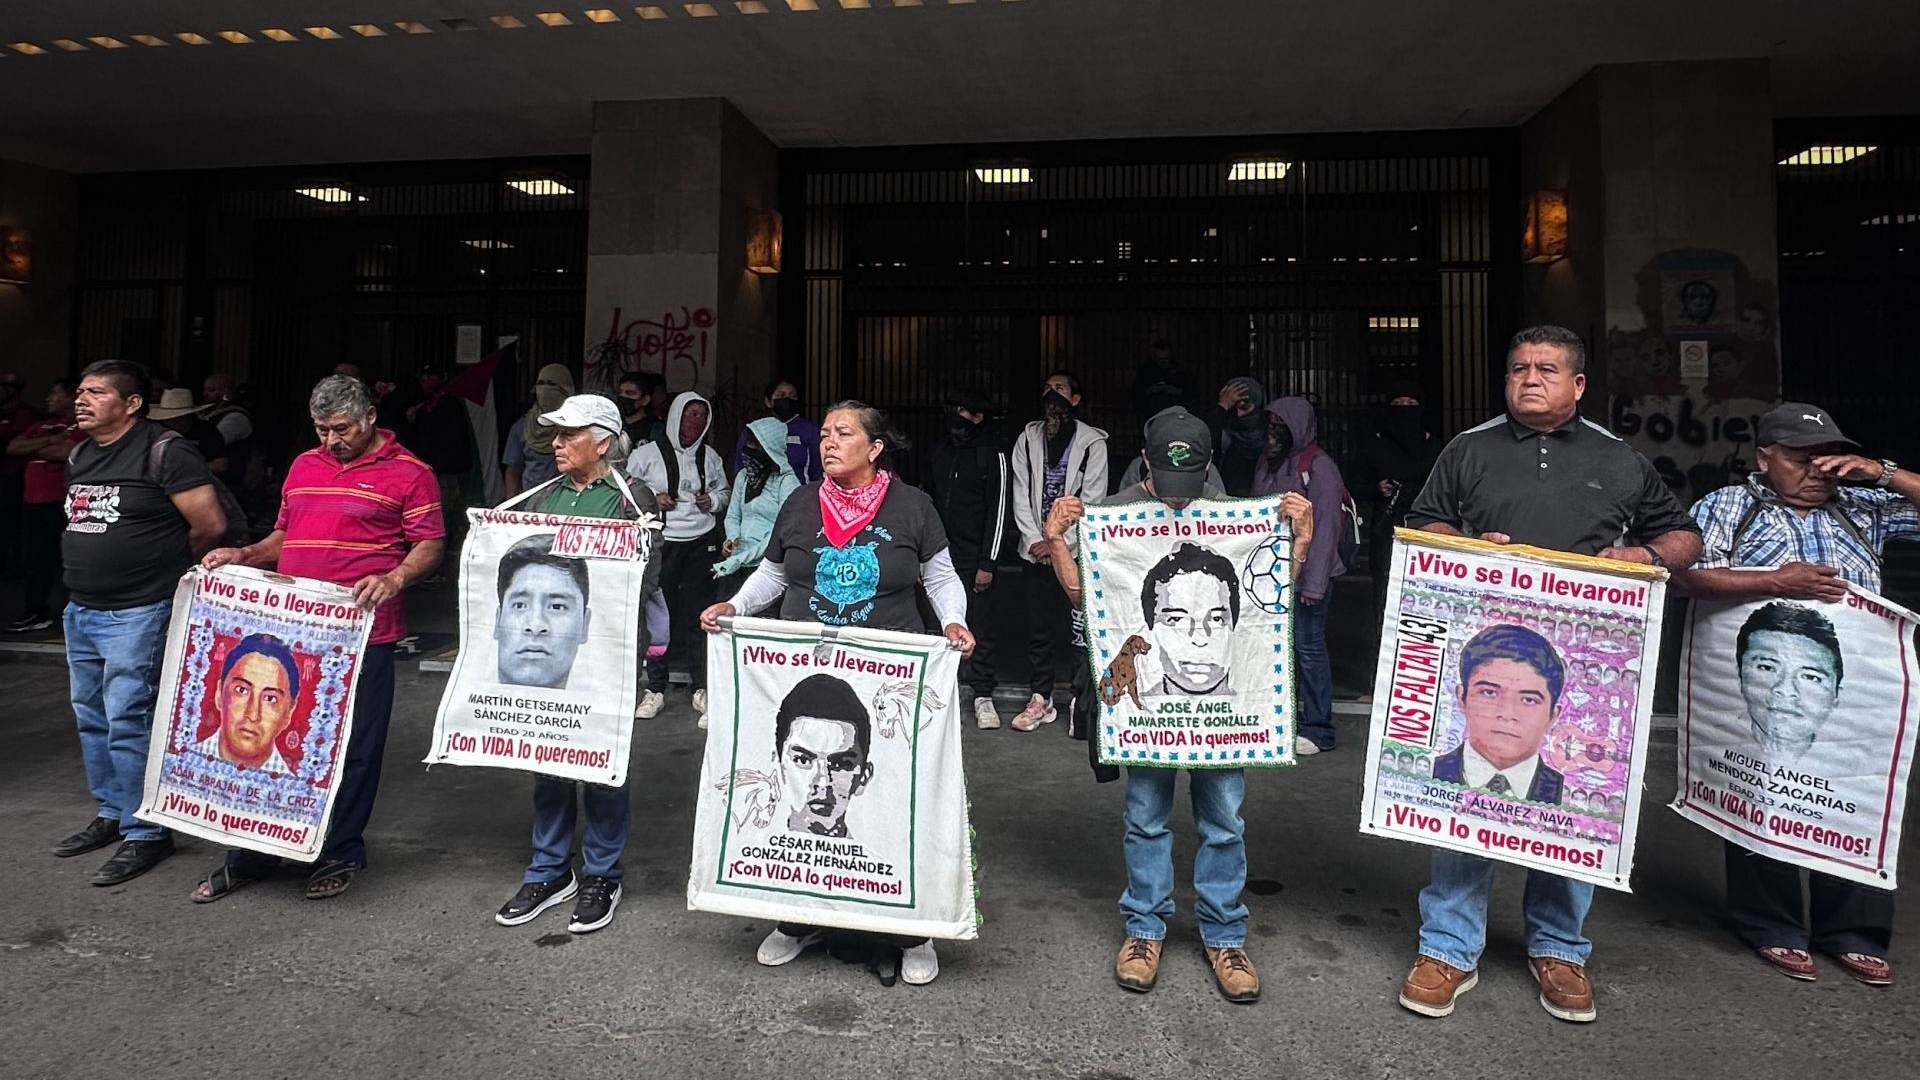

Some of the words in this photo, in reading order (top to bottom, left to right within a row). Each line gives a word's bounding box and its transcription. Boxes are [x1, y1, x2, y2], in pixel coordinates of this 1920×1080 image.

[554, 524, 585, 553] NOS
[1101, 524, 1146, 542] ¡Vivo
[1151, 525, 1170, 537] se
[1174, 521, 1191, 536] lo
[1196, 519, 1272, 537] llevaron!
[196, 574, 235, 597] ¡Vivo
[240, 588, 259, 602] se
[264, 588, 279, 607] lo
[837, 565, 856, 583] 43
[1409, 551, 1468, 579] ¡Vivo
[1475, 566, 1503, 585] se
[1511, 567, 1533, 590] lo
[1540, 572, 1645, 608] llevaron!
[851, 602, 874, 622] Sigue
[743, 645, 786, 666] ¡Vivo
[791, 653, 809, 667] se
[834, 649, 915, 679] llevaron!
[1393, 639, 1440, 705] FALTAN
[468, 693, 512, 708] MARTÍN
[515, 698, 591, 715] GETSEMANY
[474, 708, 531, 724] SÁNCHEZ
[534, 715, 581, 730] GARCÍA
[489, 727, 519, 736] EDAD
[522, 729, 535, 738] 20
[539, 730, 569, 742] AÑOS
[1128, 716, 1200, 728] NAVARRETE
[1204, 714, 1259, 728] GONZÁLEZ
[1388, 705, 1431, 745] NOS
[446, 732, 476, 752] ¡Con
[481, 735, 513, 757] VIDA
[518, 740, 530, 759] lo
[535, 745, 611, 769] queremos!
[1119, 730, 1148, 747] ¡Con
[1150, 730, 1187, 746] VIDA
[1190, 730, 1203, 746] lo
[1205, 729, 1270, 749] queremos!
[1709, 759, 1763, 789] MENDOZA
[1768, 782, 1856, 814] ZACARIAS
[1724, 750, 1770, 774] MIGUEL
[1774, 766, 1835, 792] ÁNGEL
[247, 786, 260, 799] DE
[268, 791, 281, 804] LA
[288, 795, 317, 809] CRUZ
[1422, 785, 1463, 803] JORGE
[1540, 811, 1574, 827] NAVA
[1729, 783, 1754, 799] EDAD
[1758, 795, 1775, 806] 33
[1780, 800, 1823, 820] AÑOS
[162, 793, 200, 817] ¡Vivo
[204, 804, 218, 822] lo
[221, 812, 309, 844] queremos!
[1692, 781, 1716, 805] ¡Con
[1720, 790, 1747, 819] VIDA
[1750, 804, 1764, 826] lo
[1769, 814, 1872, 857] queremos!
[769, 834, 813, 852] CÉSAR
[815, 839, 868, 858] MANUEL
[1386, 804, 1442, 832] ¡Vivo
[1450, 817, 1470, 839] lo
[1477, 828, 1603, 869] queremos!
[741, 846, 811, 865] GONZÁLEZ
[814, 854, 894, 876] HERNÁNDEZ
[728, 860, 762, 879] ¡Con
[766, 863, 802, 883] VIDA
[805, 868, 820, 885] lo
[822, 873, 902, 896] queremos!
